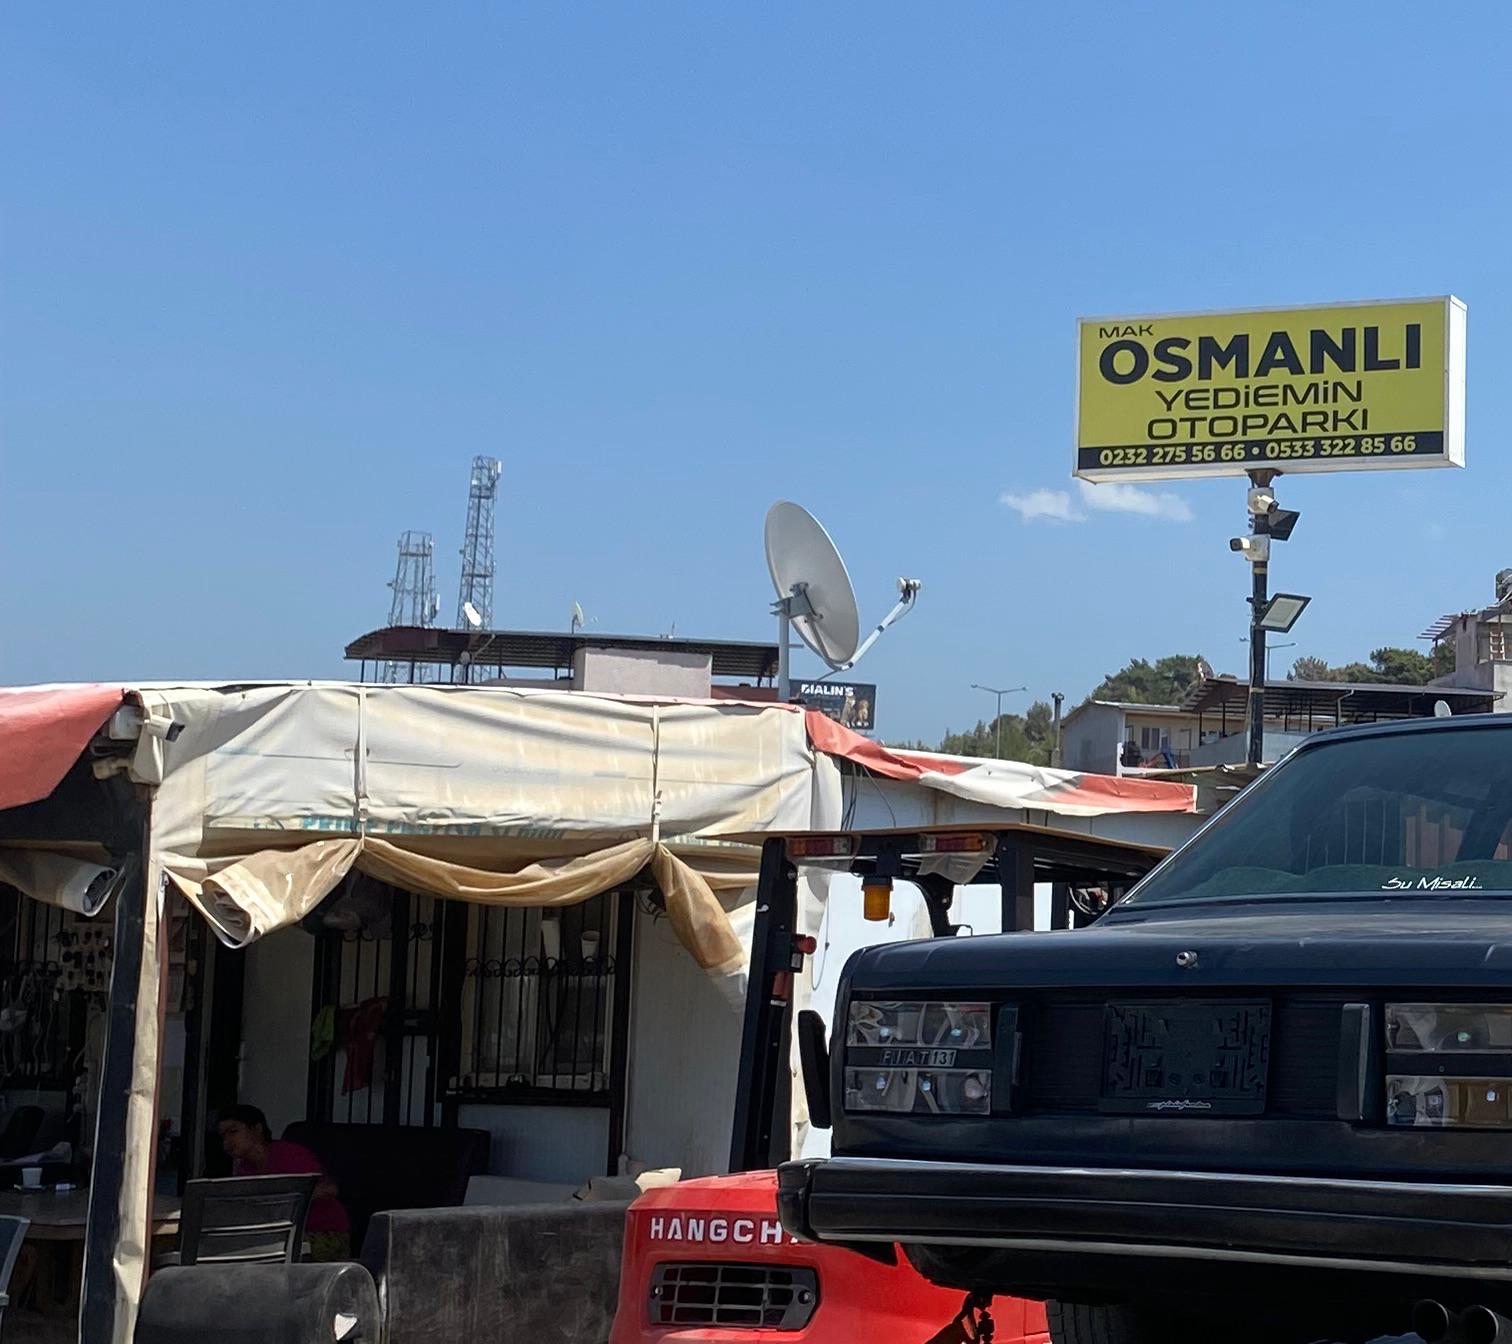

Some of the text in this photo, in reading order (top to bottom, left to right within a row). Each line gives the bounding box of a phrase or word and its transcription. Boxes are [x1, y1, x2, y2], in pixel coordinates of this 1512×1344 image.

[1099, 324, 1154, 339] MAK
[1099, 323, 1422, 385] OSMANLI
[1147, 408, 1368, 441] OTOPARKI
[1099, 436, 1416, 465] 0232 275 56 66 0533 322 85 66
[1381, 877, 1413, 890] Su
[882, 1049, 956, 1066] FIAT 131
[650, 1217, 799, 1244] HANGCH
